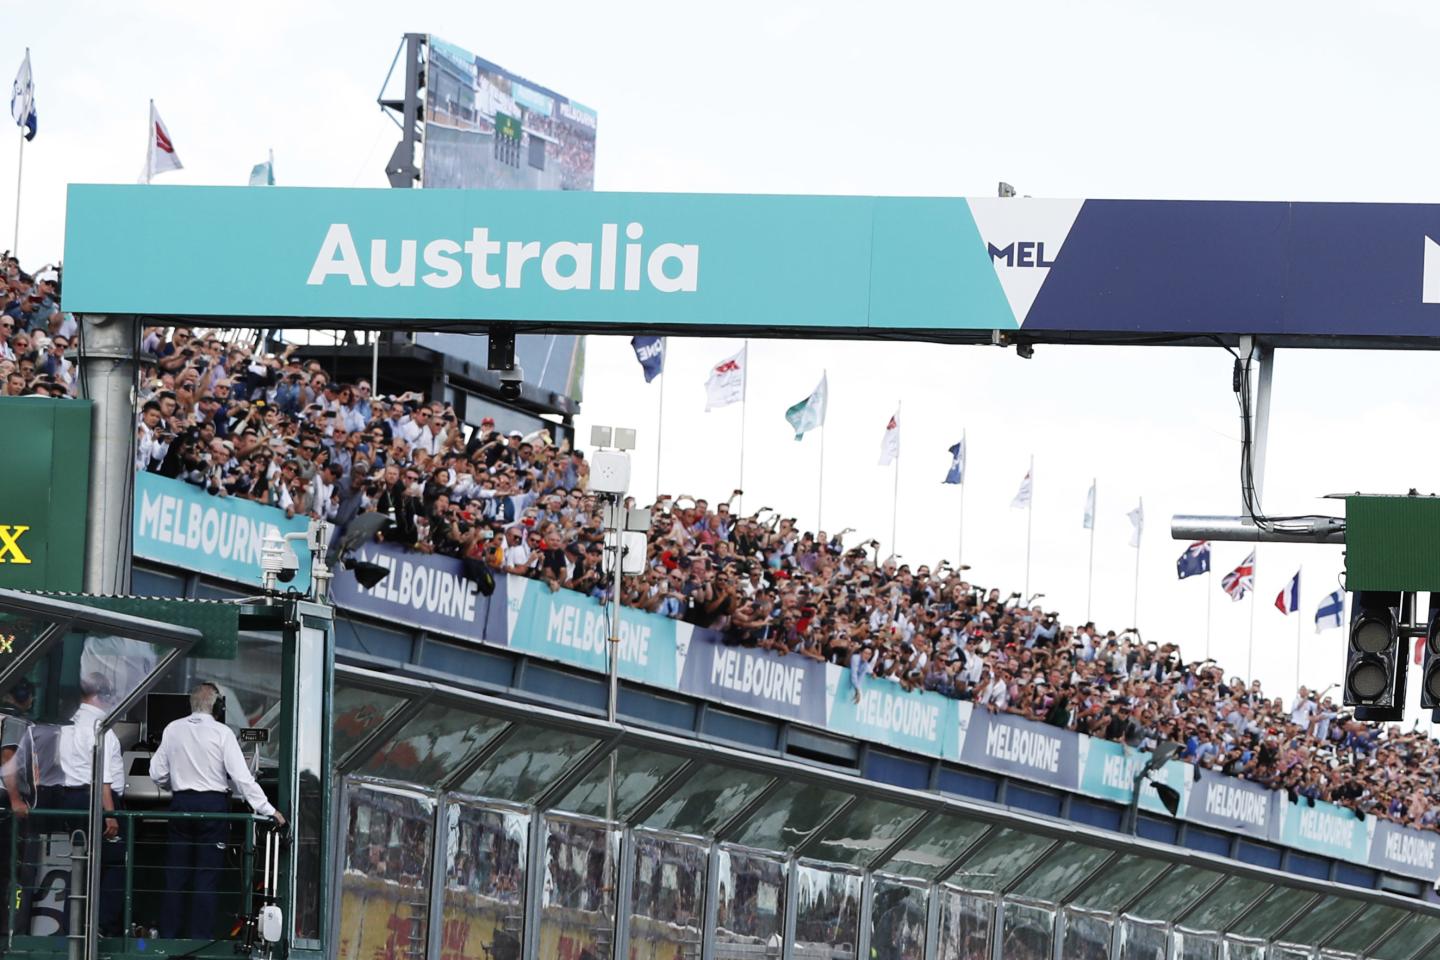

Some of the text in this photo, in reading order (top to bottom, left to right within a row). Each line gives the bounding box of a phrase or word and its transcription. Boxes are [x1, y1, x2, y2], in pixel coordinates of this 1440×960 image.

[306, 221, 699, 293] Australia
[987, 241, 1055, 269] MEL
[139, 488, 279, 567] MELBOURN
[547, 601, 652, 667] MELBORNE
[711, 645, 805, 706] MELBOURNE
[855, 689, 939, 741] MELBOURNE
[986, 721, 1062, 773] MELBOURNE
[1205, 783, 1267, 826] MELBOURNE
